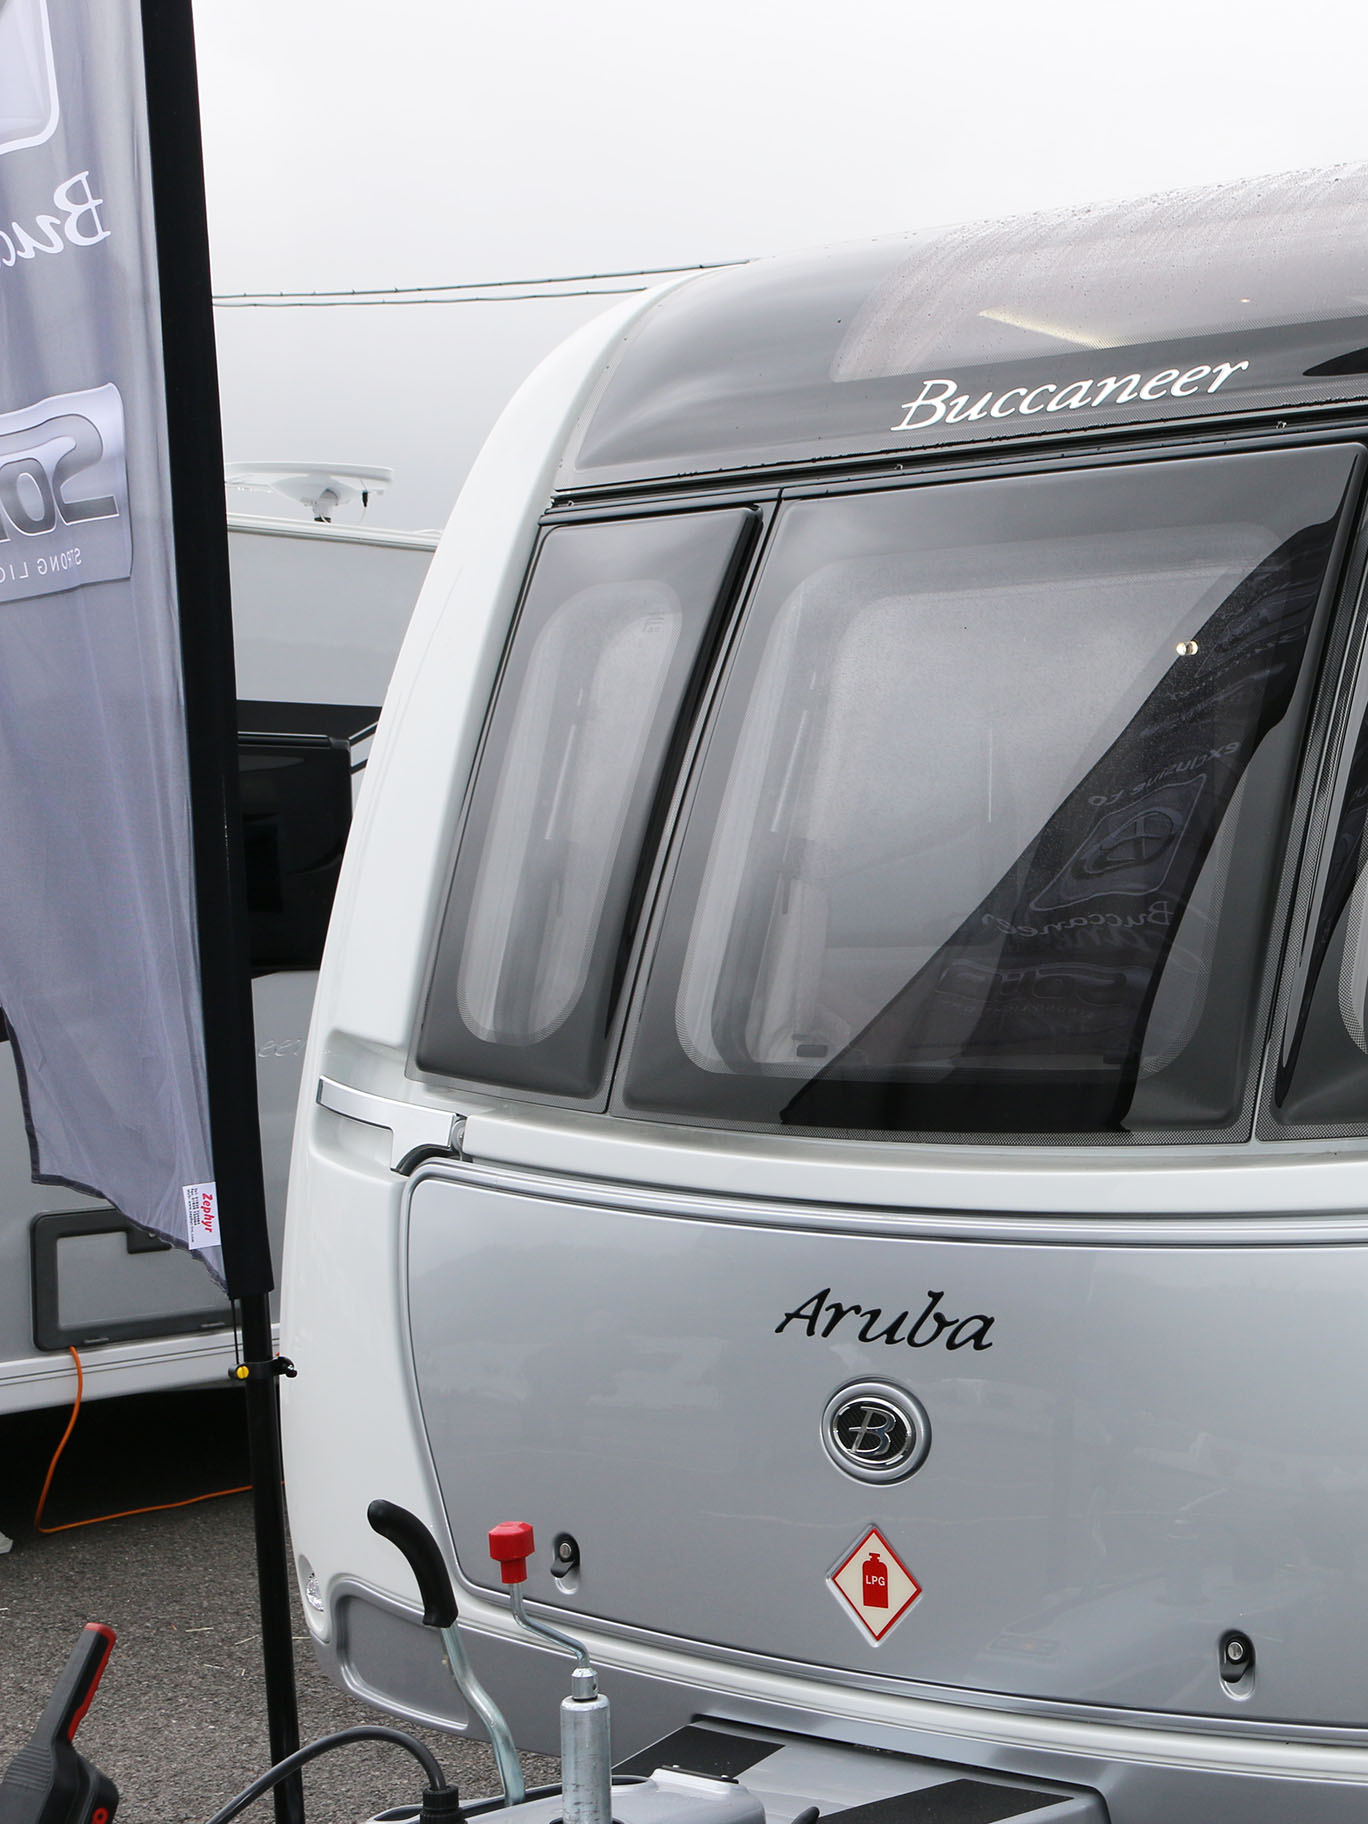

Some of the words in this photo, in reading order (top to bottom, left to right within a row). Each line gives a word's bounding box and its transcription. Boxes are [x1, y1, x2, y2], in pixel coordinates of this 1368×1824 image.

[890, 360, 1249, 432] Buccaneer
[200, 1193, 215, 1233] Zephyr
[774, 1287, 996, 1352] Aruba
[848, 1405, 897, 1456] B
[865, 1574, 886, 1586] LPG
